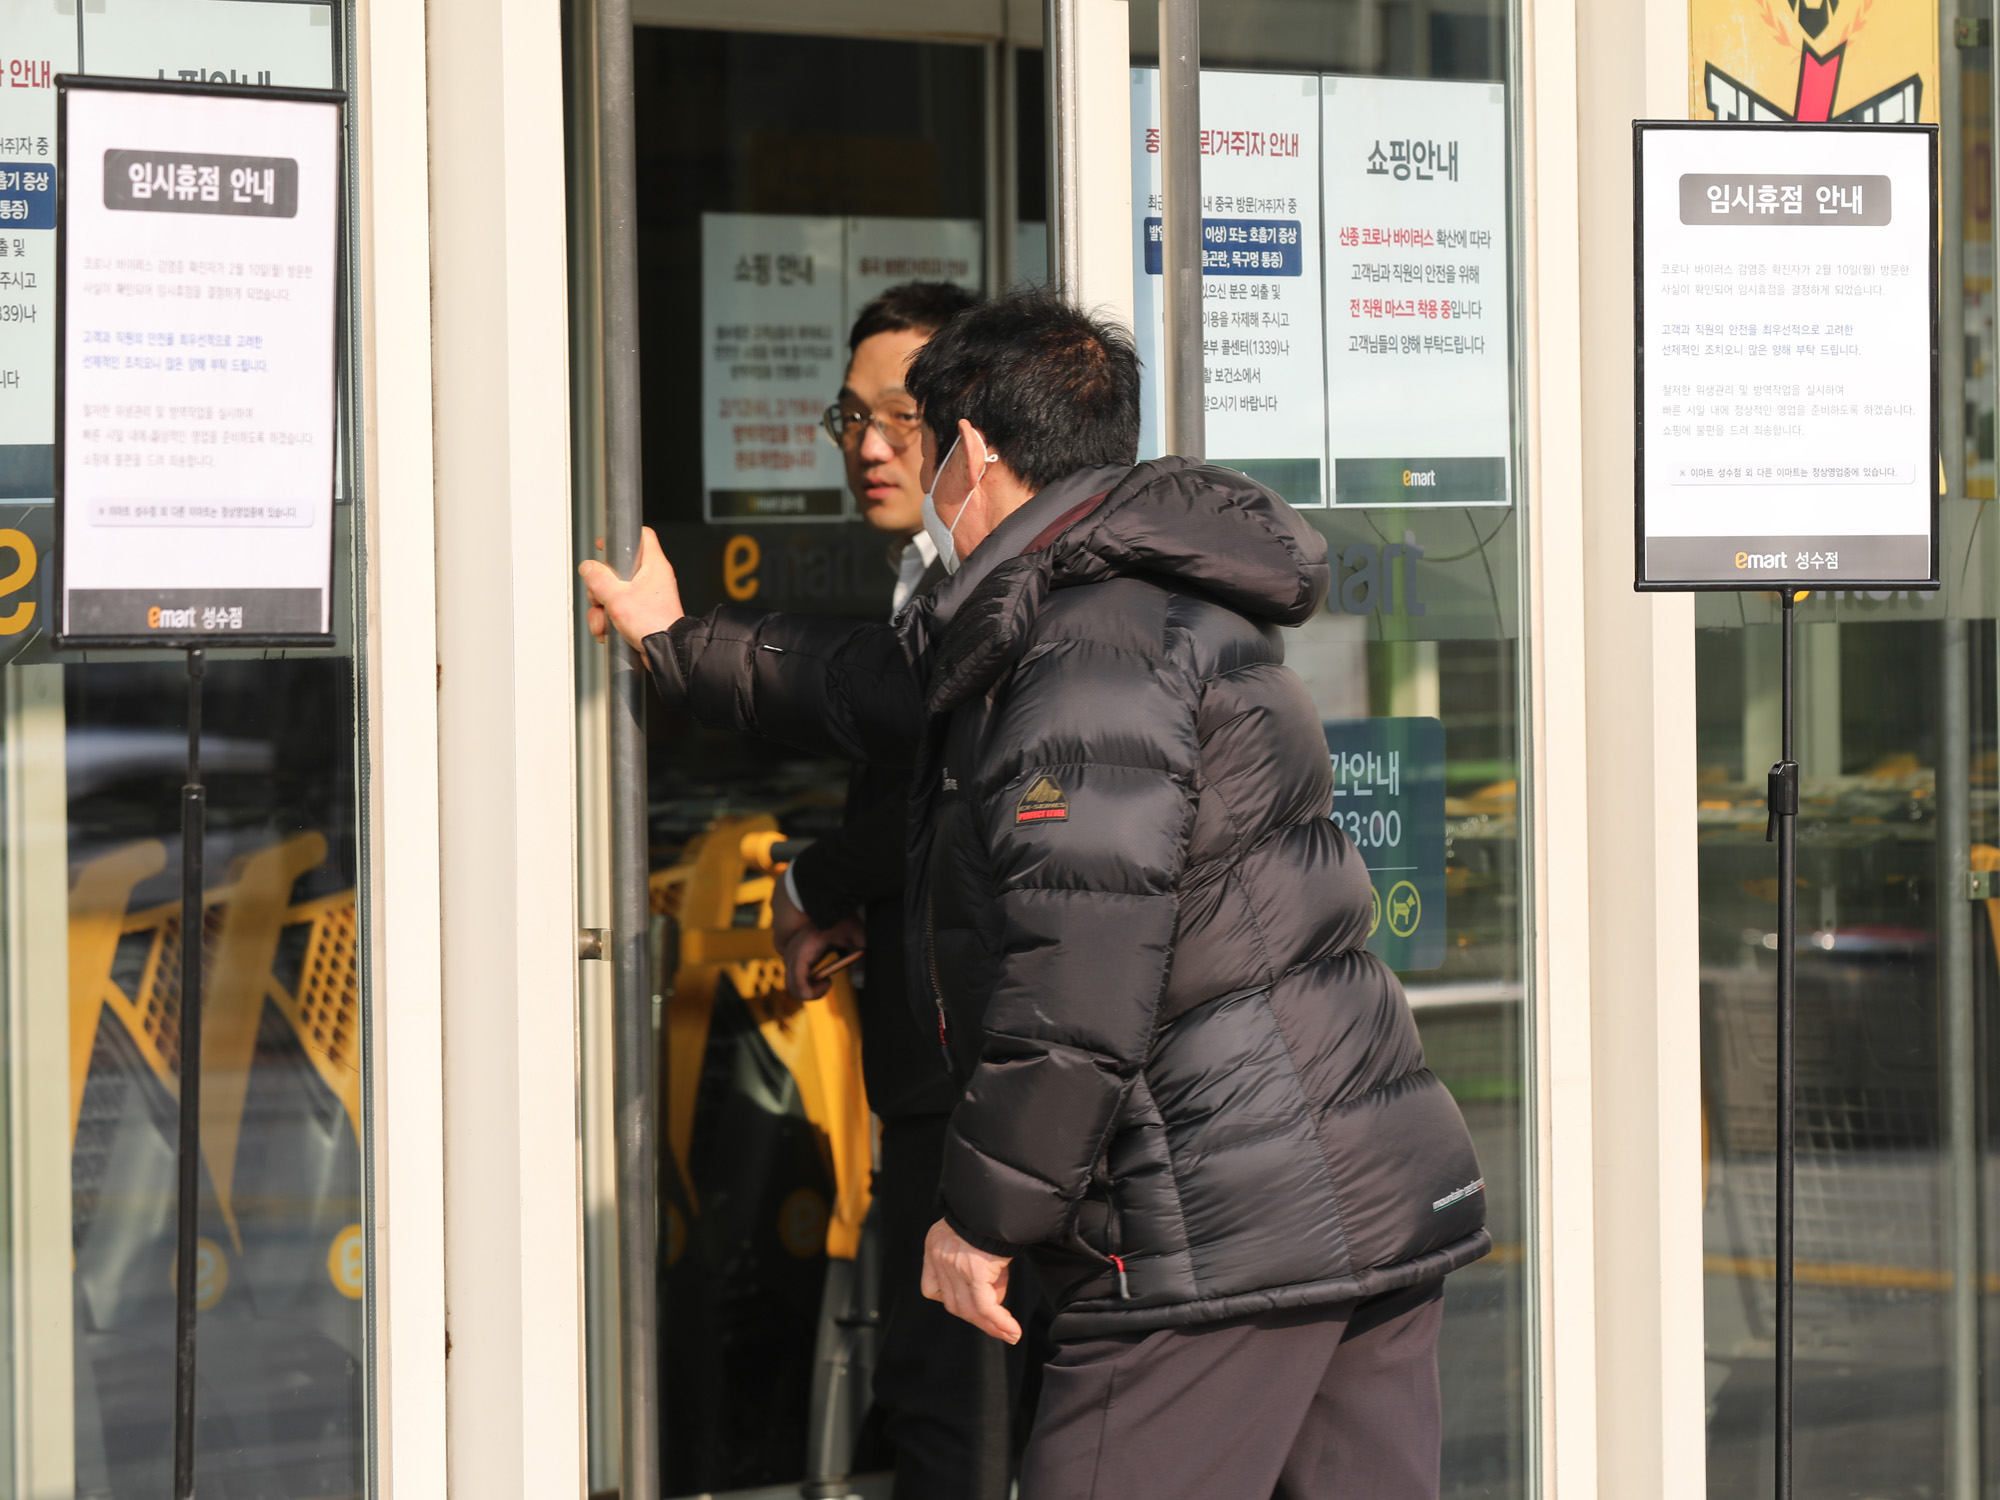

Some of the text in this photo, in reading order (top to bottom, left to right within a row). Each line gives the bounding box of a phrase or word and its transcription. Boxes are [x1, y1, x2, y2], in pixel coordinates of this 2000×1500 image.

[11, 59, 50, 88] 안내
[36, 137, 49, 155] 중
[1201, 130, 1299, 158] 문[거주]자 안내
[1367, 139, 1458, 182] 쇼핑안내
[23, 172, 49, 191] 증상
[128, 162, 275, 205] 임시휴점 안내
[1215, 197, 1233, 212] 중국
[1237, 197, 1285, 214] 방문[거주]자
[1288, 198, 1297, 214] 중
[1707, 184, 1862, 215] 임시휴점 안내
[1206, 226, 1227, 242] 이상)
[1229, 227, 1247, 242] 또는
[1250, 227, 1277, 243] 호흡기
[1278, 228, 1297, 244] 증상
[1339, 227, 1491, 250] 신종 코로나 바이러스 확산에 따라
[13, 238, 25, 257] 및
[1232, 252, 1259, 268] 목구멍
[1261, 252, 1283, 268] 통증)
[1351, 263, 1480, 284] 고객님과 직원의 안전을 위해
[1661, 264, 1909, 276] 코로나 바이러스 감염증 확진자가 2월 10일(월) 방문한
[0, 271, 37, 290] 주시고
[1229, 284, 1247, 299] 분은
[1251, 284, 1269, 300] 외출
[1272, 284, 1281, 300] 및
[1661, 284, 1886, 296] 사실이 확인되어 임시휴점을 결정하게 되었습니다.
[1350, 299, 1482, 319] 전 직원 마스크 착용 중입니다
[1231, 312, 1259, 327] 자제해
[1262, 312, 1289, 327] 주시고
[1662, 324, 1854, 335] 고객과 직원의 안전을 최우선적으로 고려한
[1221, 339, 1289, 356] 콜센터(1339)나
[1349, 334, 1485, 355] 고객님들의 양해 부탁드립니다
[1662, 344, 1861, 356] 선제적인 조치오니 많은 양해 부탁 드립니다.
[1215, 368, 1261, 384] 보건소에서
[1662, 385, 1844, 396] 철저한 위생관리 및 방역작업을 실시하여
[1240, 396, 1277, 411] 바랍니다
[1662, 405, 1916, 417] 빠른 시일 내에 정상적인 영업을 준비하도록 하겠습니다.
[1662, 425, 1805, 437] 쇼핑에 불편을 드려 죄송합니다.
[1402, 469, 1435, 487] emart
[1690, 468, 1898, 477] 이마트 성수점 외 다른 이마트는 정상영업중에 있습니다.
[1735, 551, 1839, 570] emart 성수점
[148, 605, 243, 629] emart 성수점
